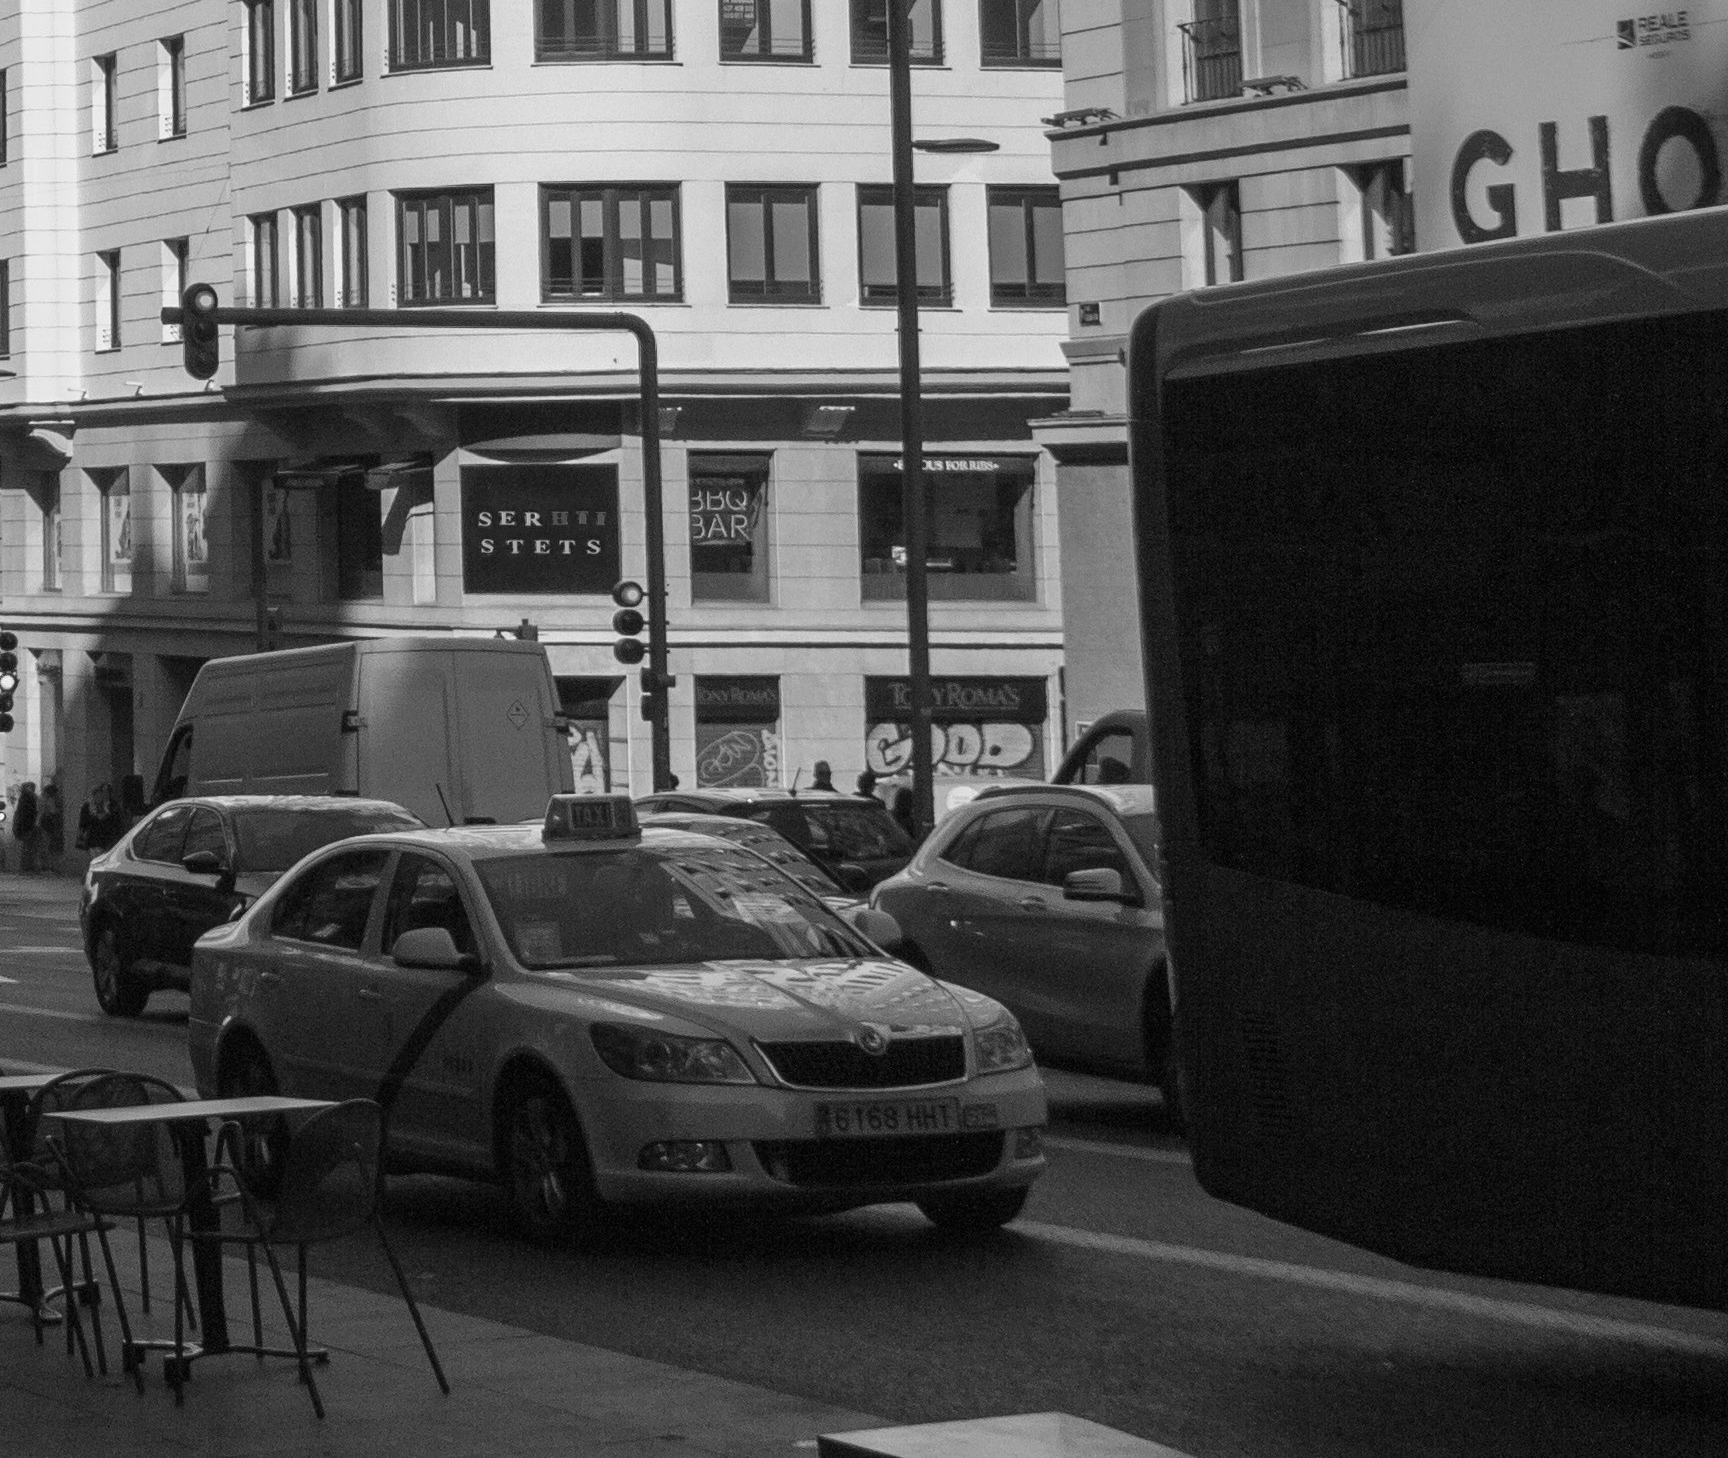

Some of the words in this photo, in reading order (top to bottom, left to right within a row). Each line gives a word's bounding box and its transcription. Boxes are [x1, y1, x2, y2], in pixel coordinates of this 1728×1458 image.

[1637, 10, 1689, 33] REALE
[691, 488, 749, 513] BBQ
[692, 513, 751, 540] BAR
[480, 538, 603, 555] STETS
